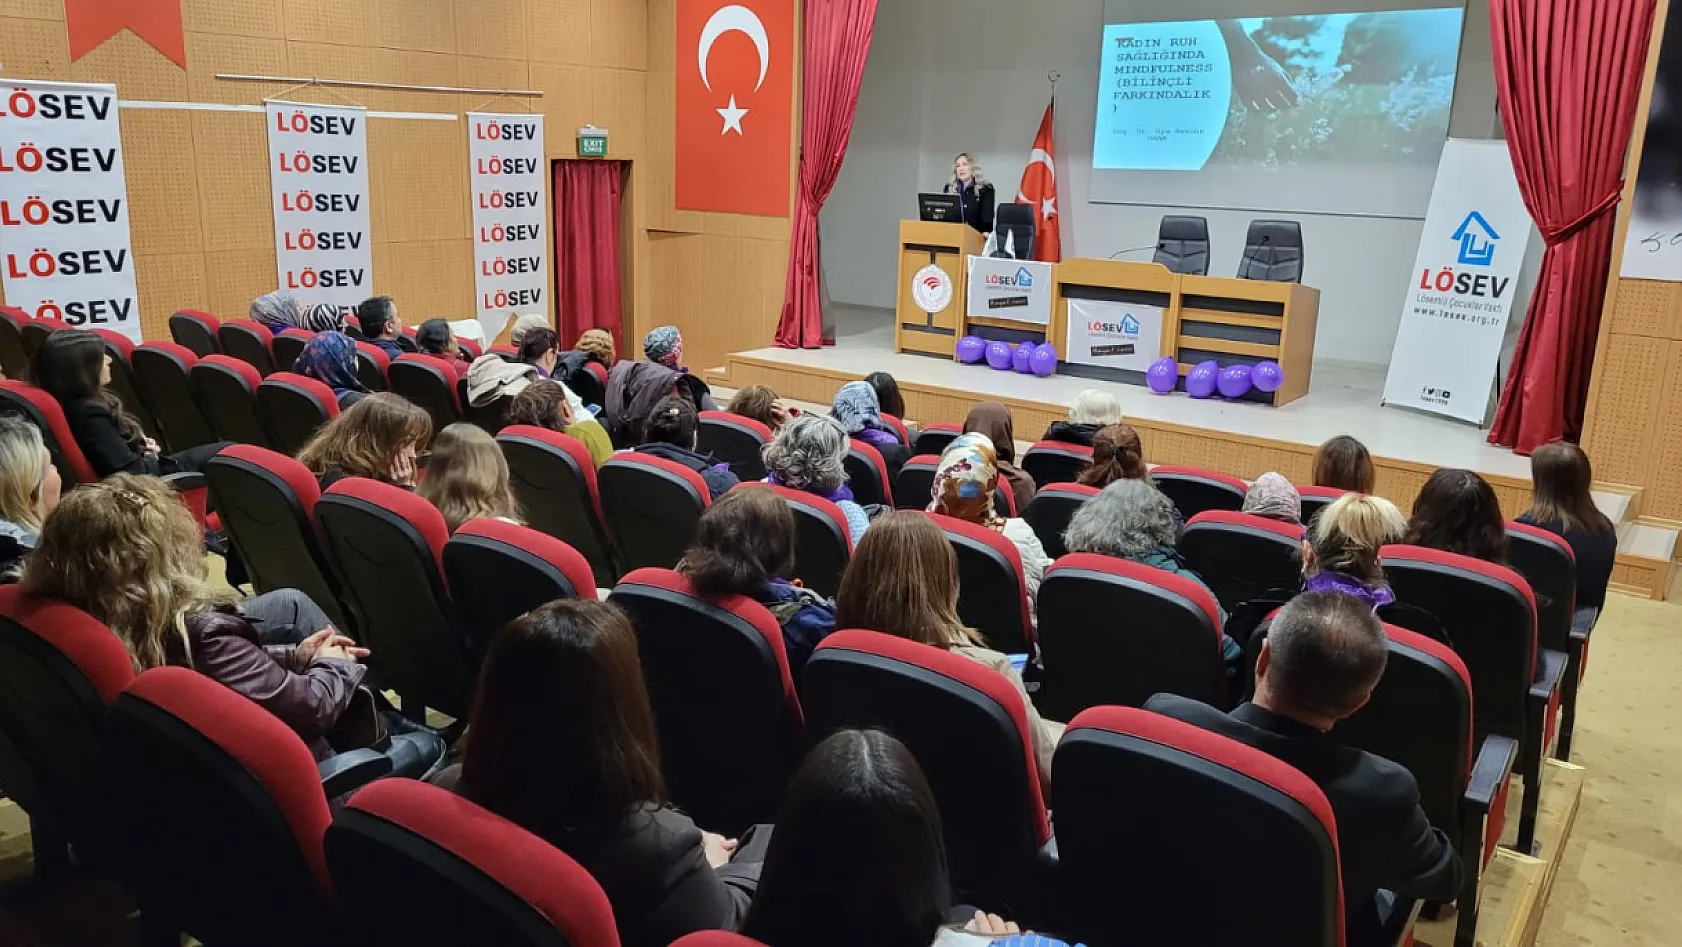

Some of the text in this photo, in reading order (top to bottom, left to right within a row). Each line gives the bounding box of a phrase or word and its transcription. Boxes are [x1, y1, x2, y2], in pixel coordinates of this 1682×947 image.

[1169, 37, 1197, 47] RUH
[1114, 63, 1213, 74] MINDFULNESS
[0, 87, 111, 120] ÖSEV
[1113, 90, 1211, 100] FARKINDALIK
[277, 109, 356, 136] LÖSEV
[476, 120, 536, 141] LÖSEV
[279, 150, 358, 174] LÖSEV
[477, 156, 537, 175] LÖSEV
[1, 196, 121, 225] LÖSEV
[281, 189, 360, 212] LÖSEV
[479, 190, 538, 209] LÖSEV
[284, 229, 362, 251] LÖSEV
[481, 223, 540, 243] LÖSEV
[6, 248, 126, 278] LÖSEV
[481, 256, 540, 276] LÖSEV
[287, 267, 364, 289] LÖSEV
[1420, 266, 1510, 298] LÖSEV
[484, 288, 541, 309] LÖSEV
[16, 298, 131, 325] ÖSEV
